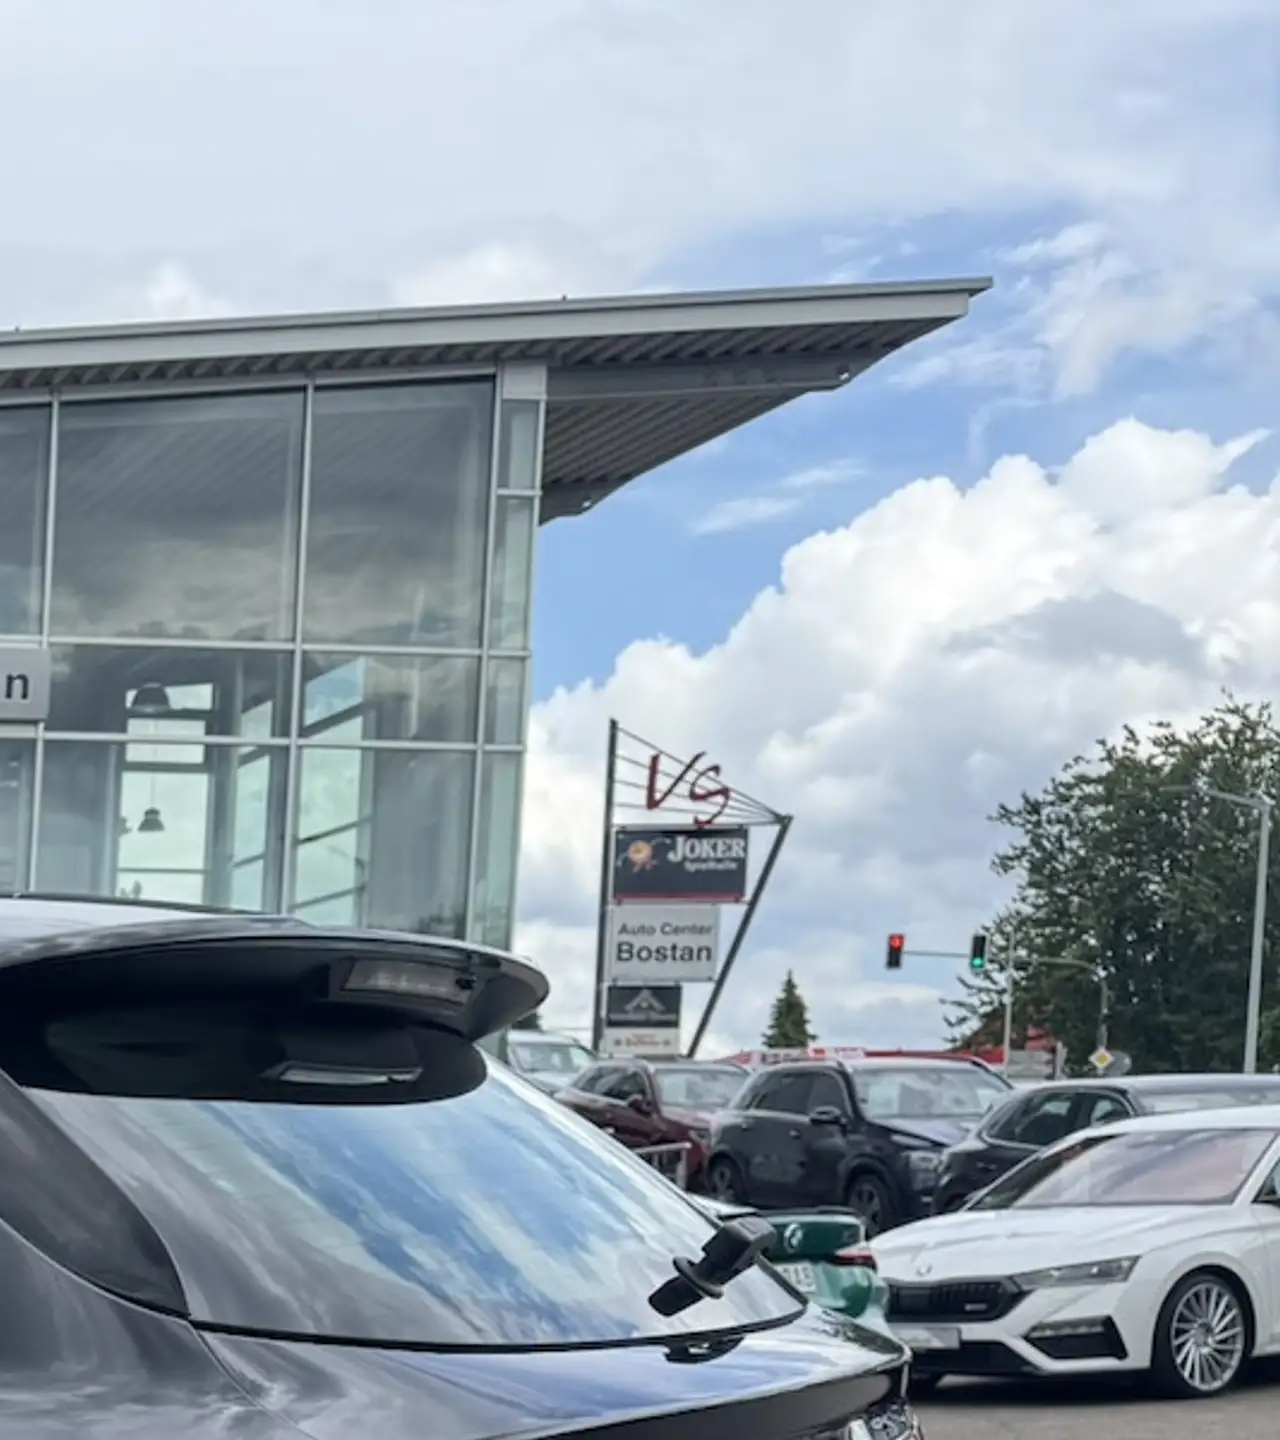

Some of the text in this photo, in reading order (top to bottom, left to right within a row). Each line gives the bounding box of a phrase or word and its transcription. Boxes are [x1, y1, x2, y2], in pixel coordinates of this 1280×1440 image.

[646, 751, 730, 827] VS
[667, 835, 746, 863] JOKER
[617, 922, 714, 936] Auto Center
[615, 941, 713, 962] Bostan
